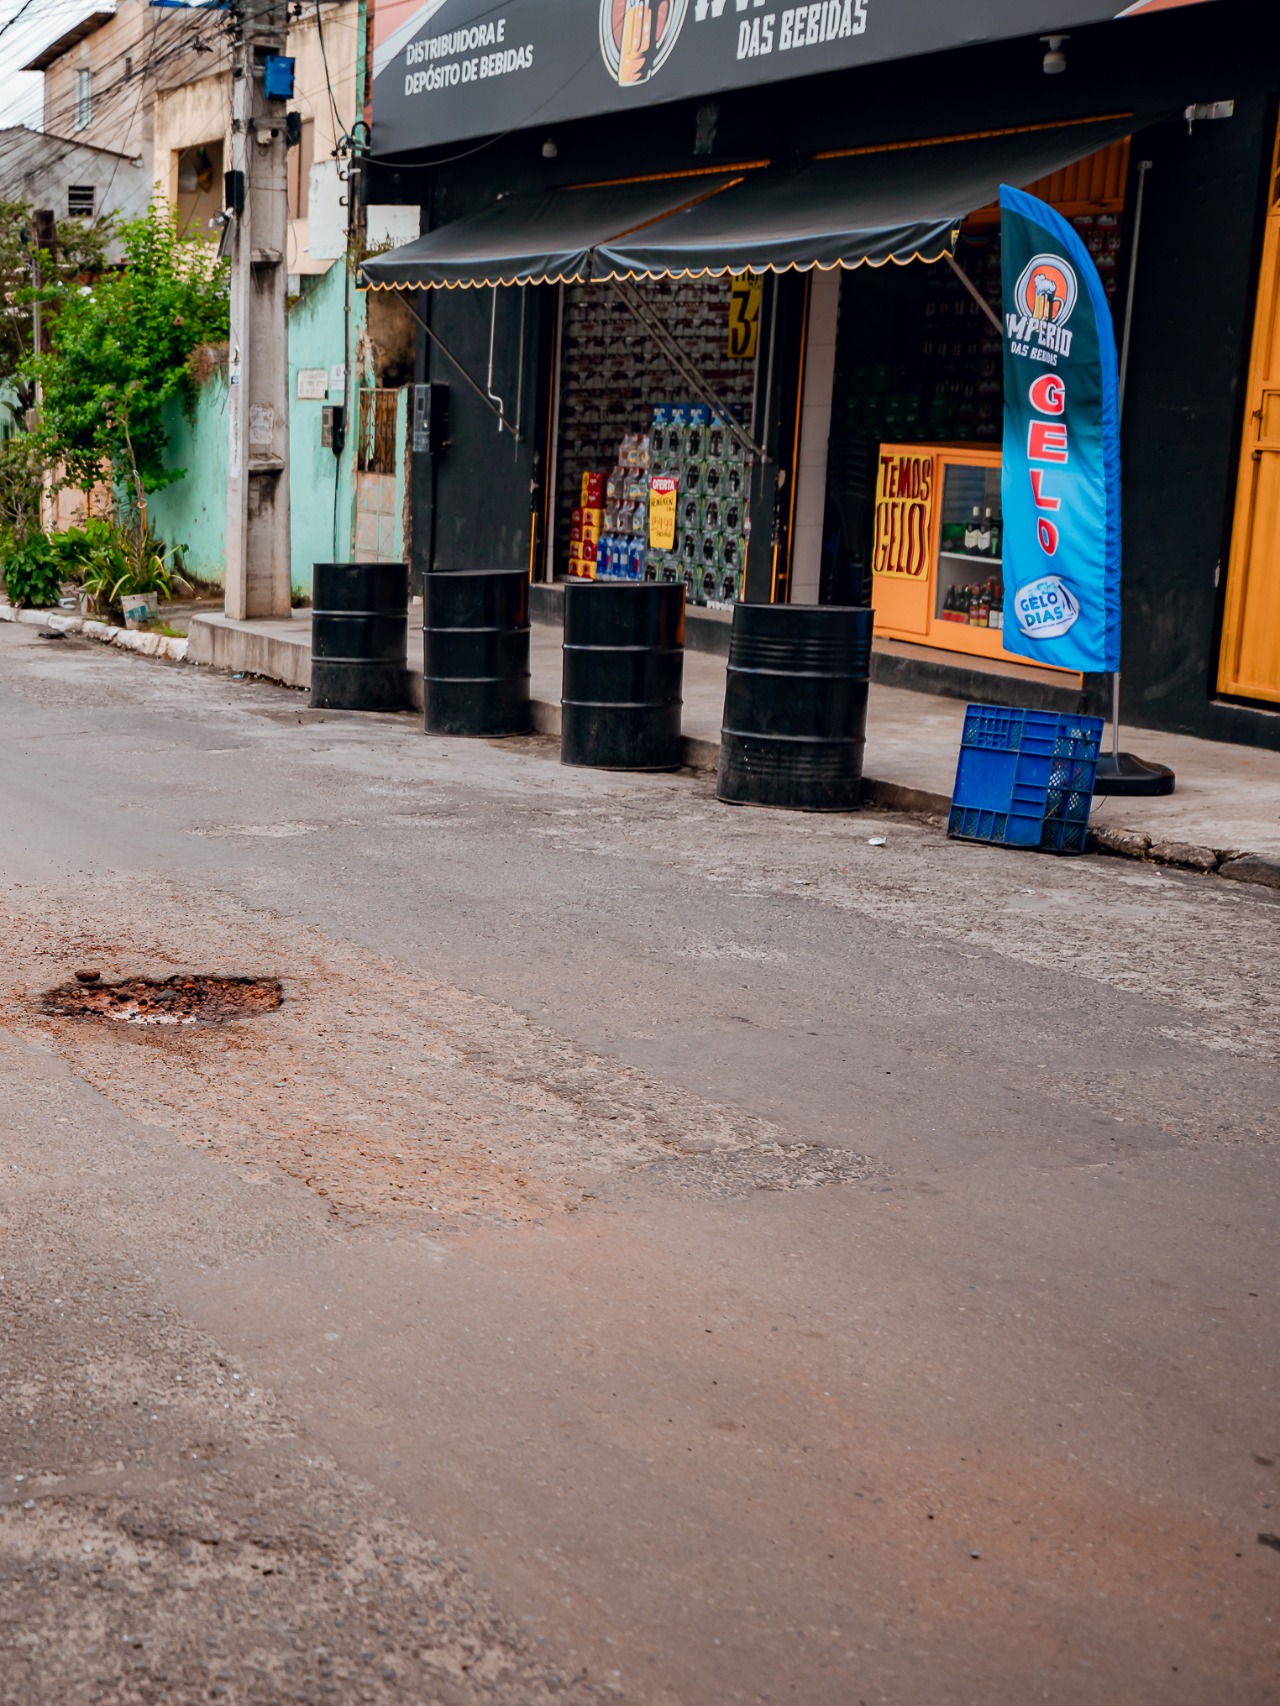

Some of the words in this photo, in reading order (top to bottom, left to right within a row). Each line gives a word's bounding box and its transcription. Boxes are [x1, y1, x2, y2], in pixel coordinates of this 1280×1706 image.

[406, 21, 496, 66] DISTRIBUIDORA
[496, 18, 506, 42] E
[737, 14, 776, 60] DAS
[779, 0, 868, 50] BEBIDAS
[404, 63, 460, 96] DEPÓSITO
[461, 58, 479, 82] DE
[480, 44, 534, 79] BEBIDAS
[1010, 341, 1029, 357] DAS
[652, 478, 675, 491] OFERTA
[880, 455, 933, 501] TEMOS
[1027, 373, 1069, 557] GELO
[874, 502, 927, 576] GELO
[1020, 592, 1058, 612] GELO
[1024, 605, 1063, 627] DIAS
